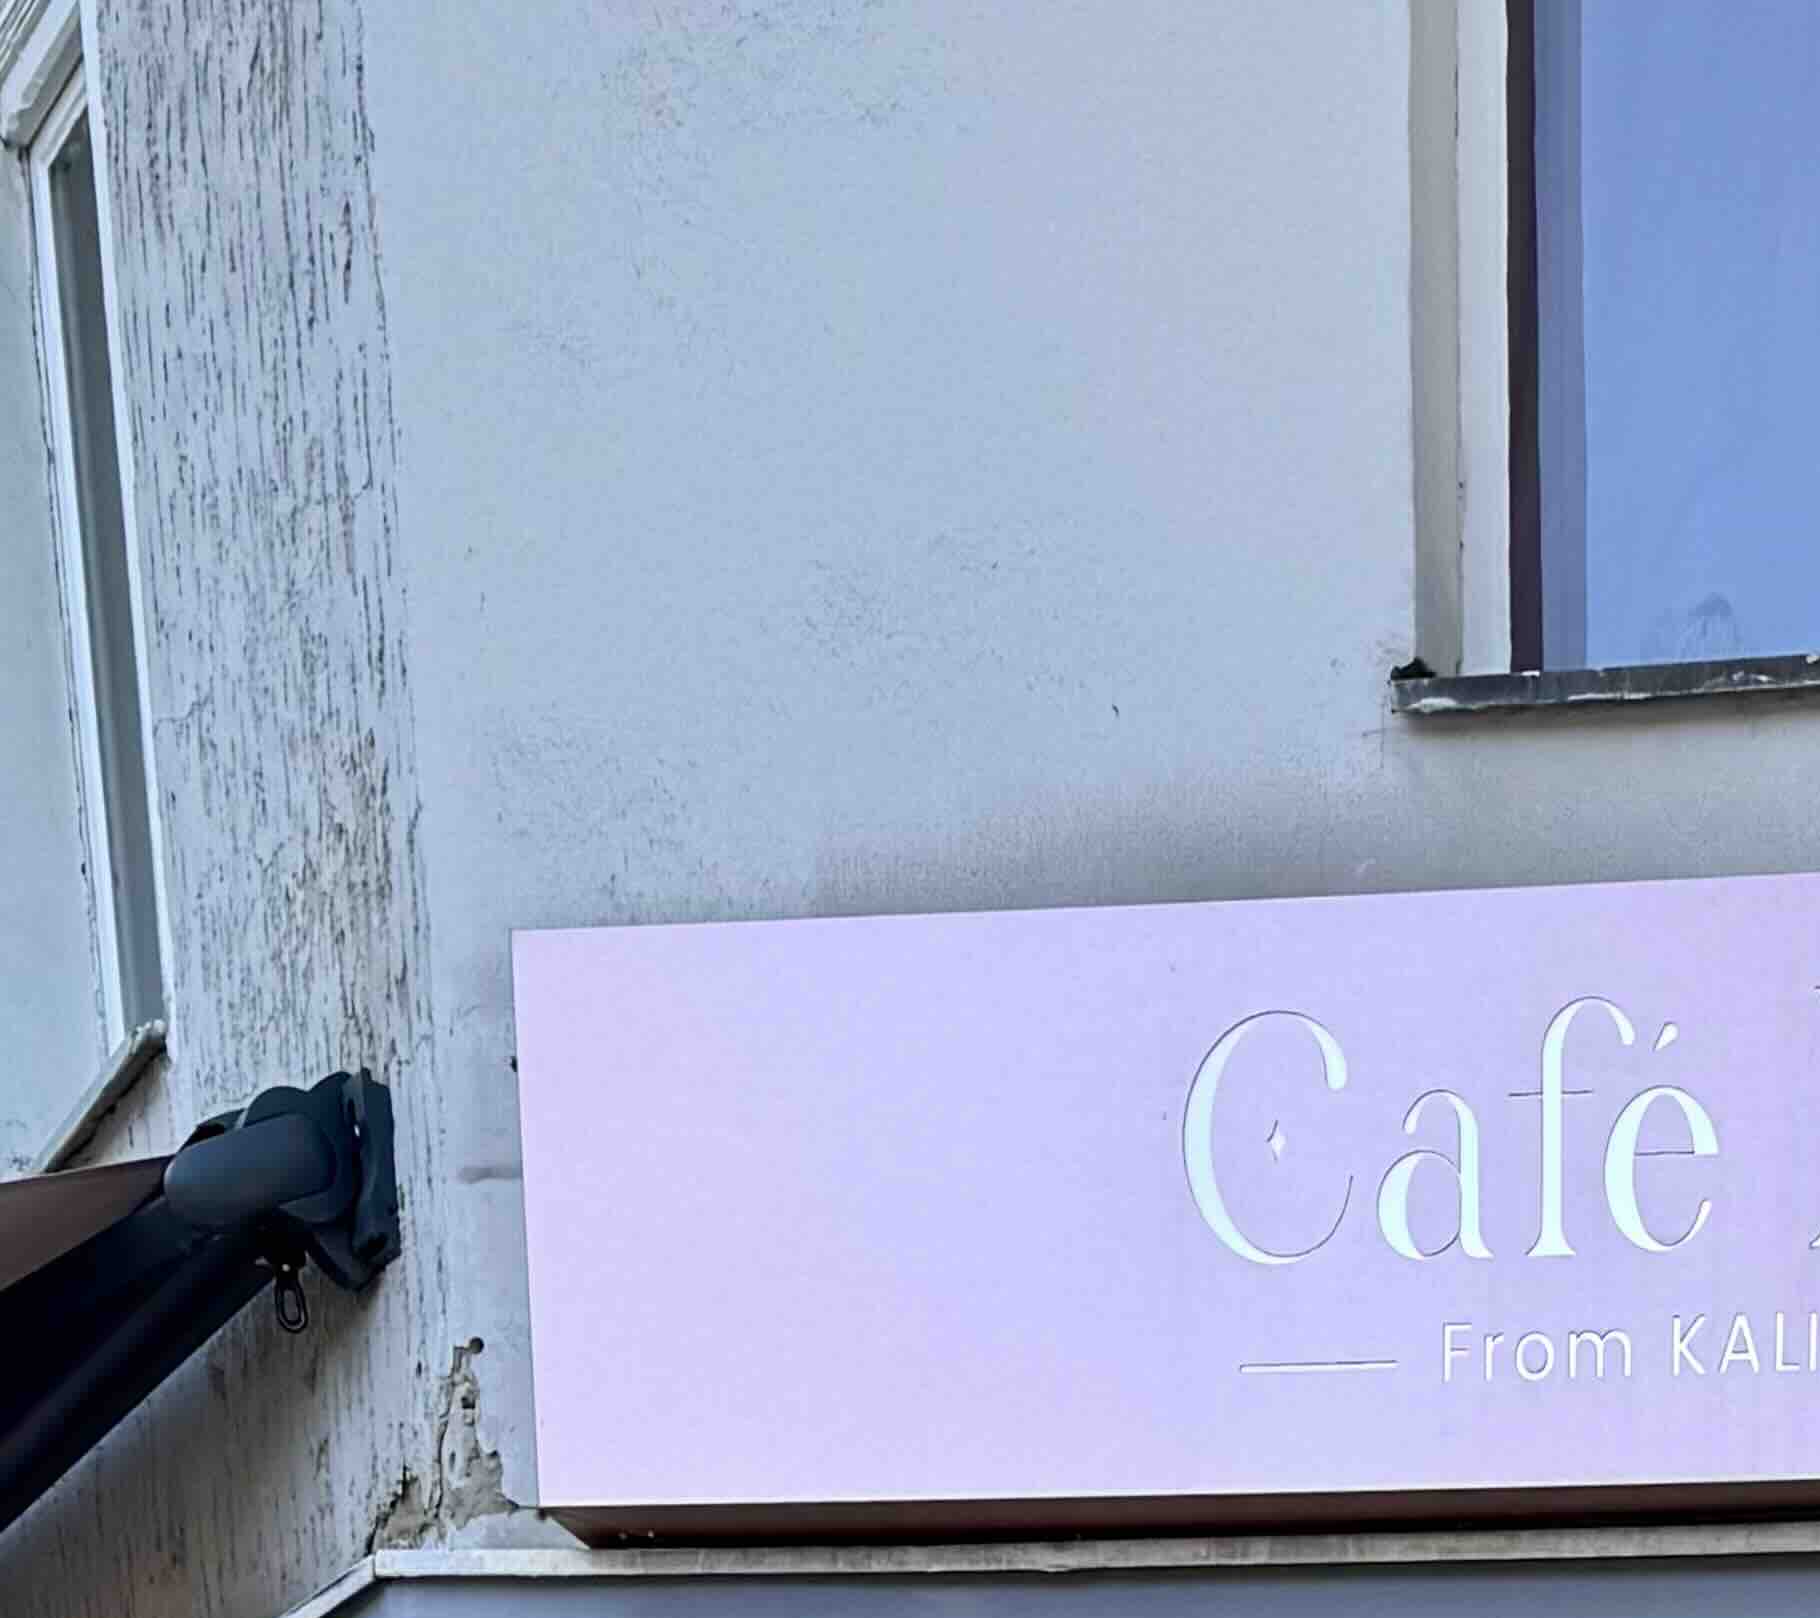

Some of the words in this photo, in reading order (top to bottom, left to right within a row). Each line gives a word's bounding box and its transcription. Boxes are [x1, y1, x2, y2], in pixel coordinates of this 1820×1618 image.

[1182, 997, 1719, 1263] Café
[1441, 1320, 1633, 1383] From
[1670, 1311, 1819, 1375] KALI
